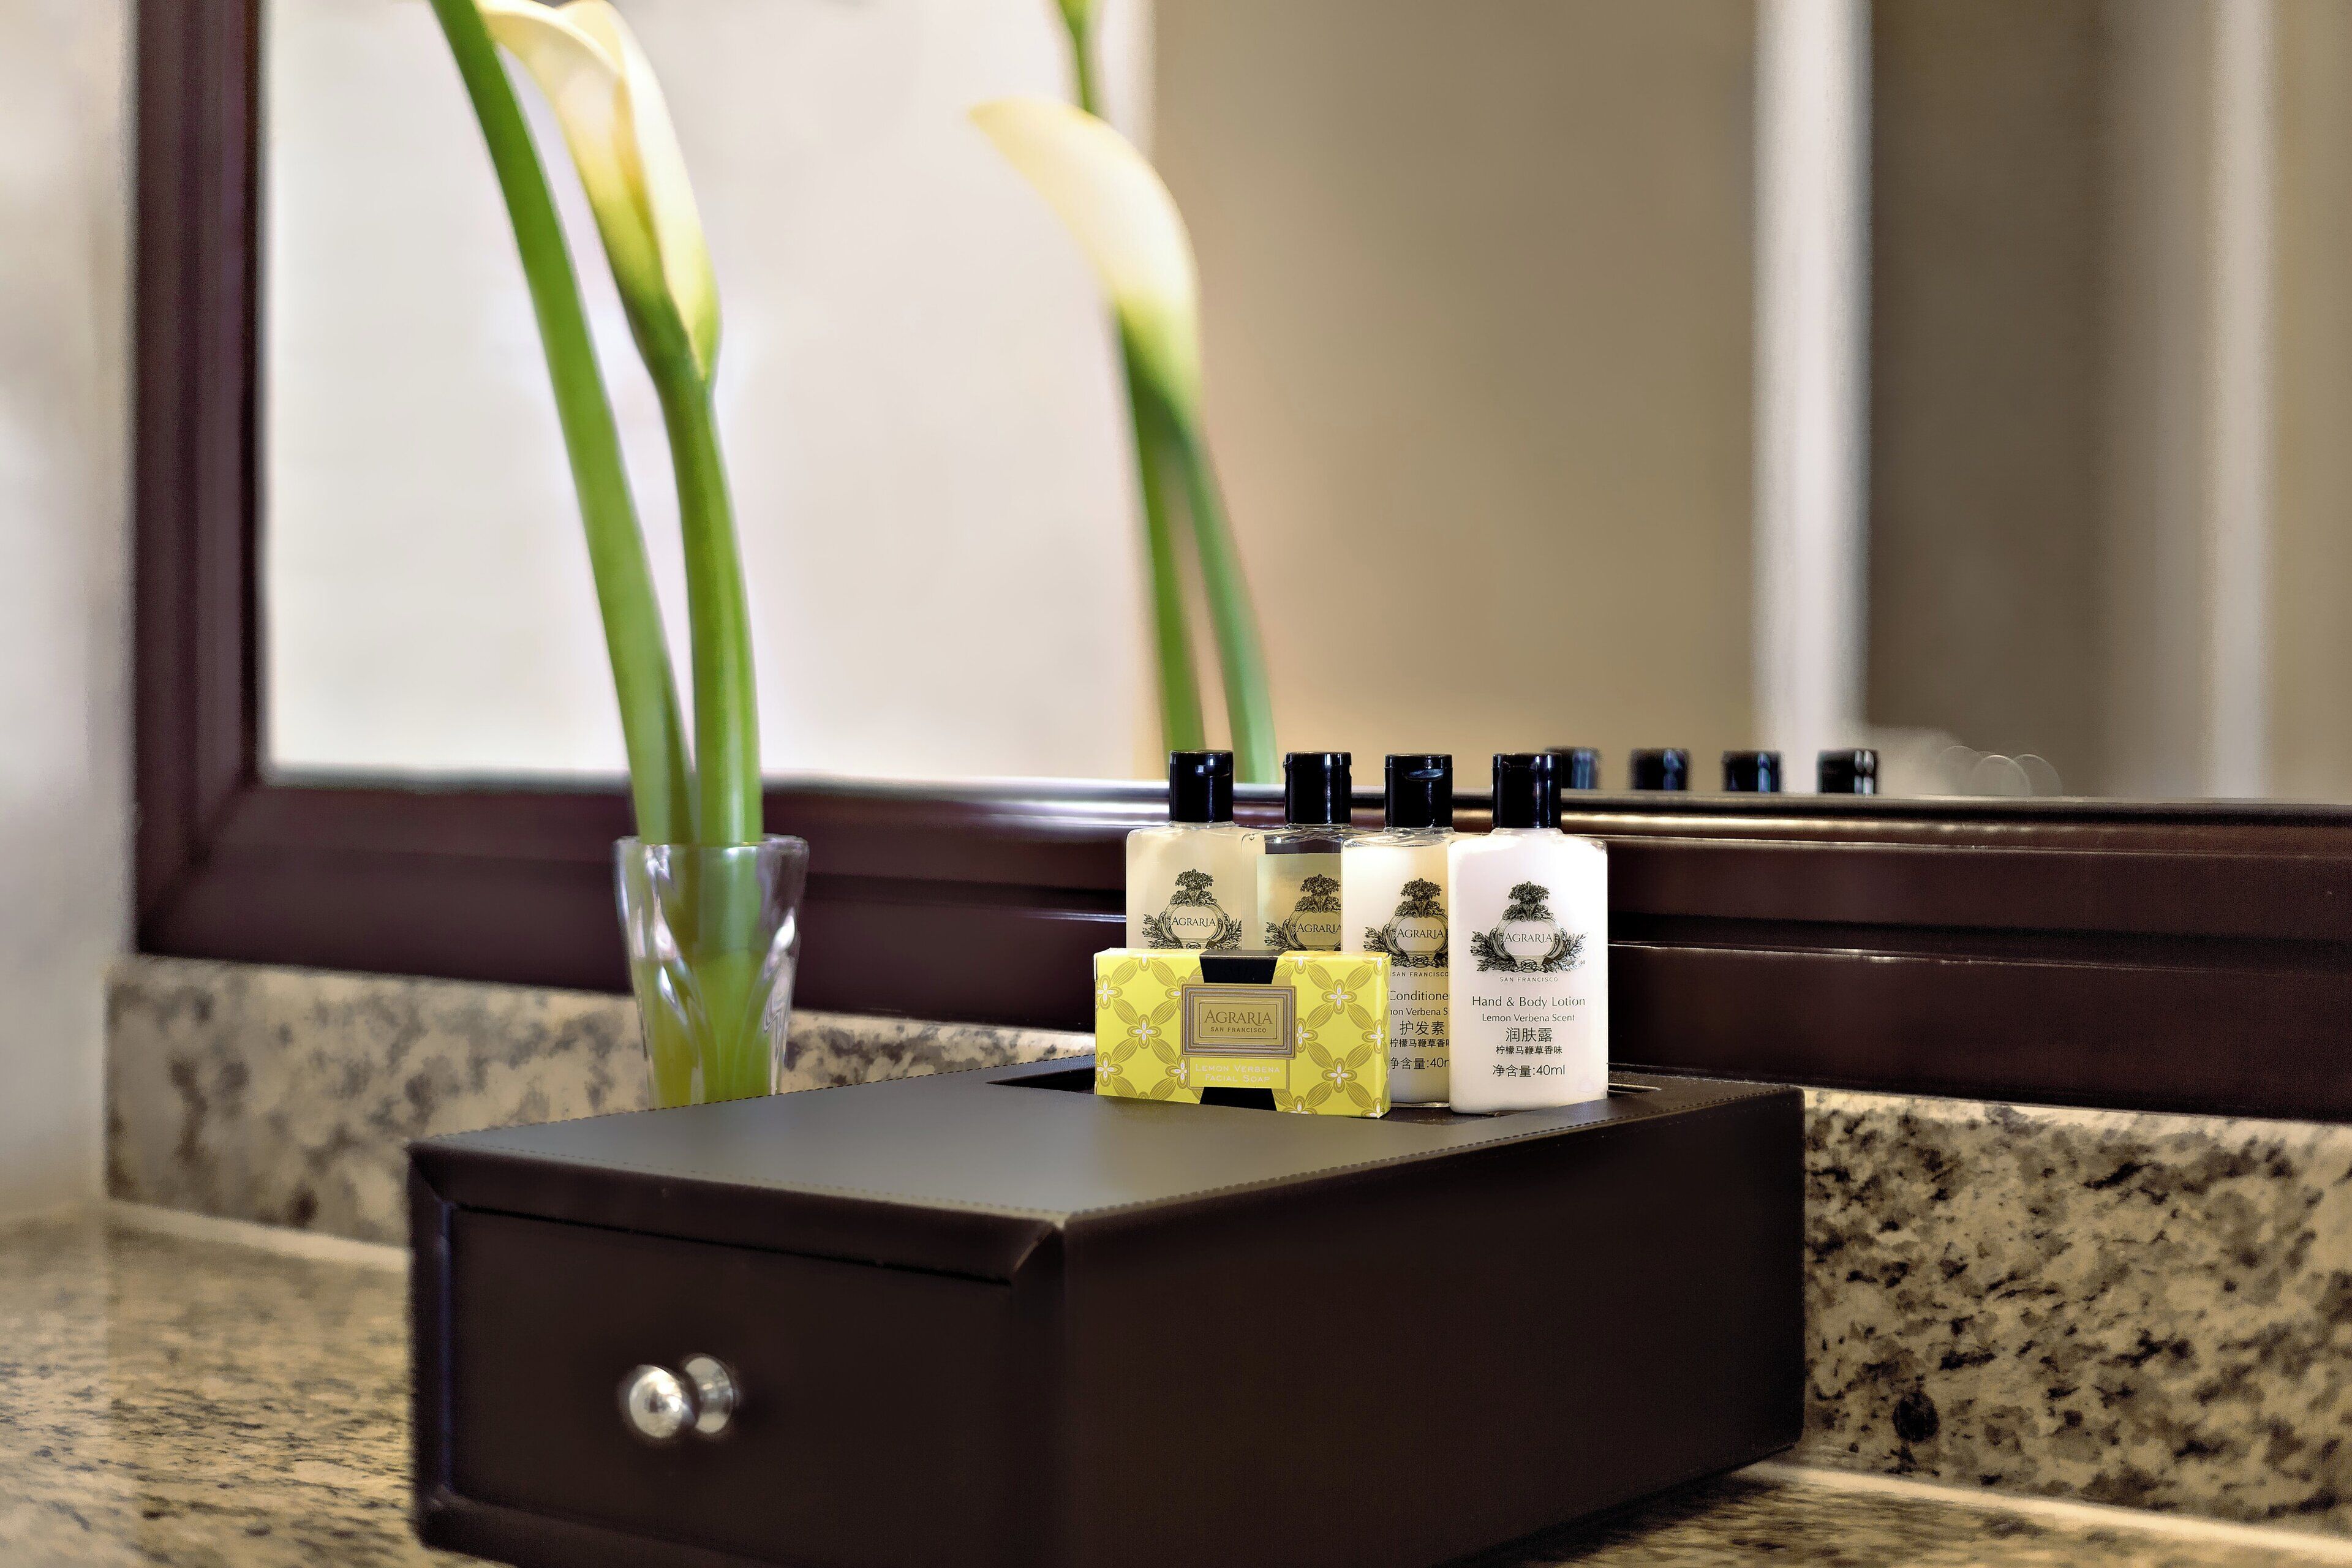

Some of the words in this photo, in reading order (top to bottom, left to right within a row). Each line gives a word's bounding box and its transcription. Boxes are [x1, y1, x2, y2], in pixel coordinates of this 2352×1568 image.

[1171, 916, 1216, 927] AGRARIA
[1297, 923, 1341, 934] AGRARIA
[1396, 928, 1445, 940] AGRARIA
[1504, 933, 1553, 944] AGRARIA
[1472, 996, 1504, 1006] Hand
[1506, 997, 1515, 1006] &
[1519, 997, 1548, 1009] Body
[1551, 996, 1586, 1006] Lotion
[1406, 1007, 1441, 1016] Verbena
[1204, 1009, 1273, 1026] AGRARIA
[1400, 1020, 1445, 1036] 护发素
[1506, 1027, 1553, 1042] 润肤露
[1495, 1045, 1563, 1055] 柠檬马鞭草香味
[1234, 1065, 1281, 1073] VERBENA
[1492, 1063, 1566, 1078] 净含量:40ml
